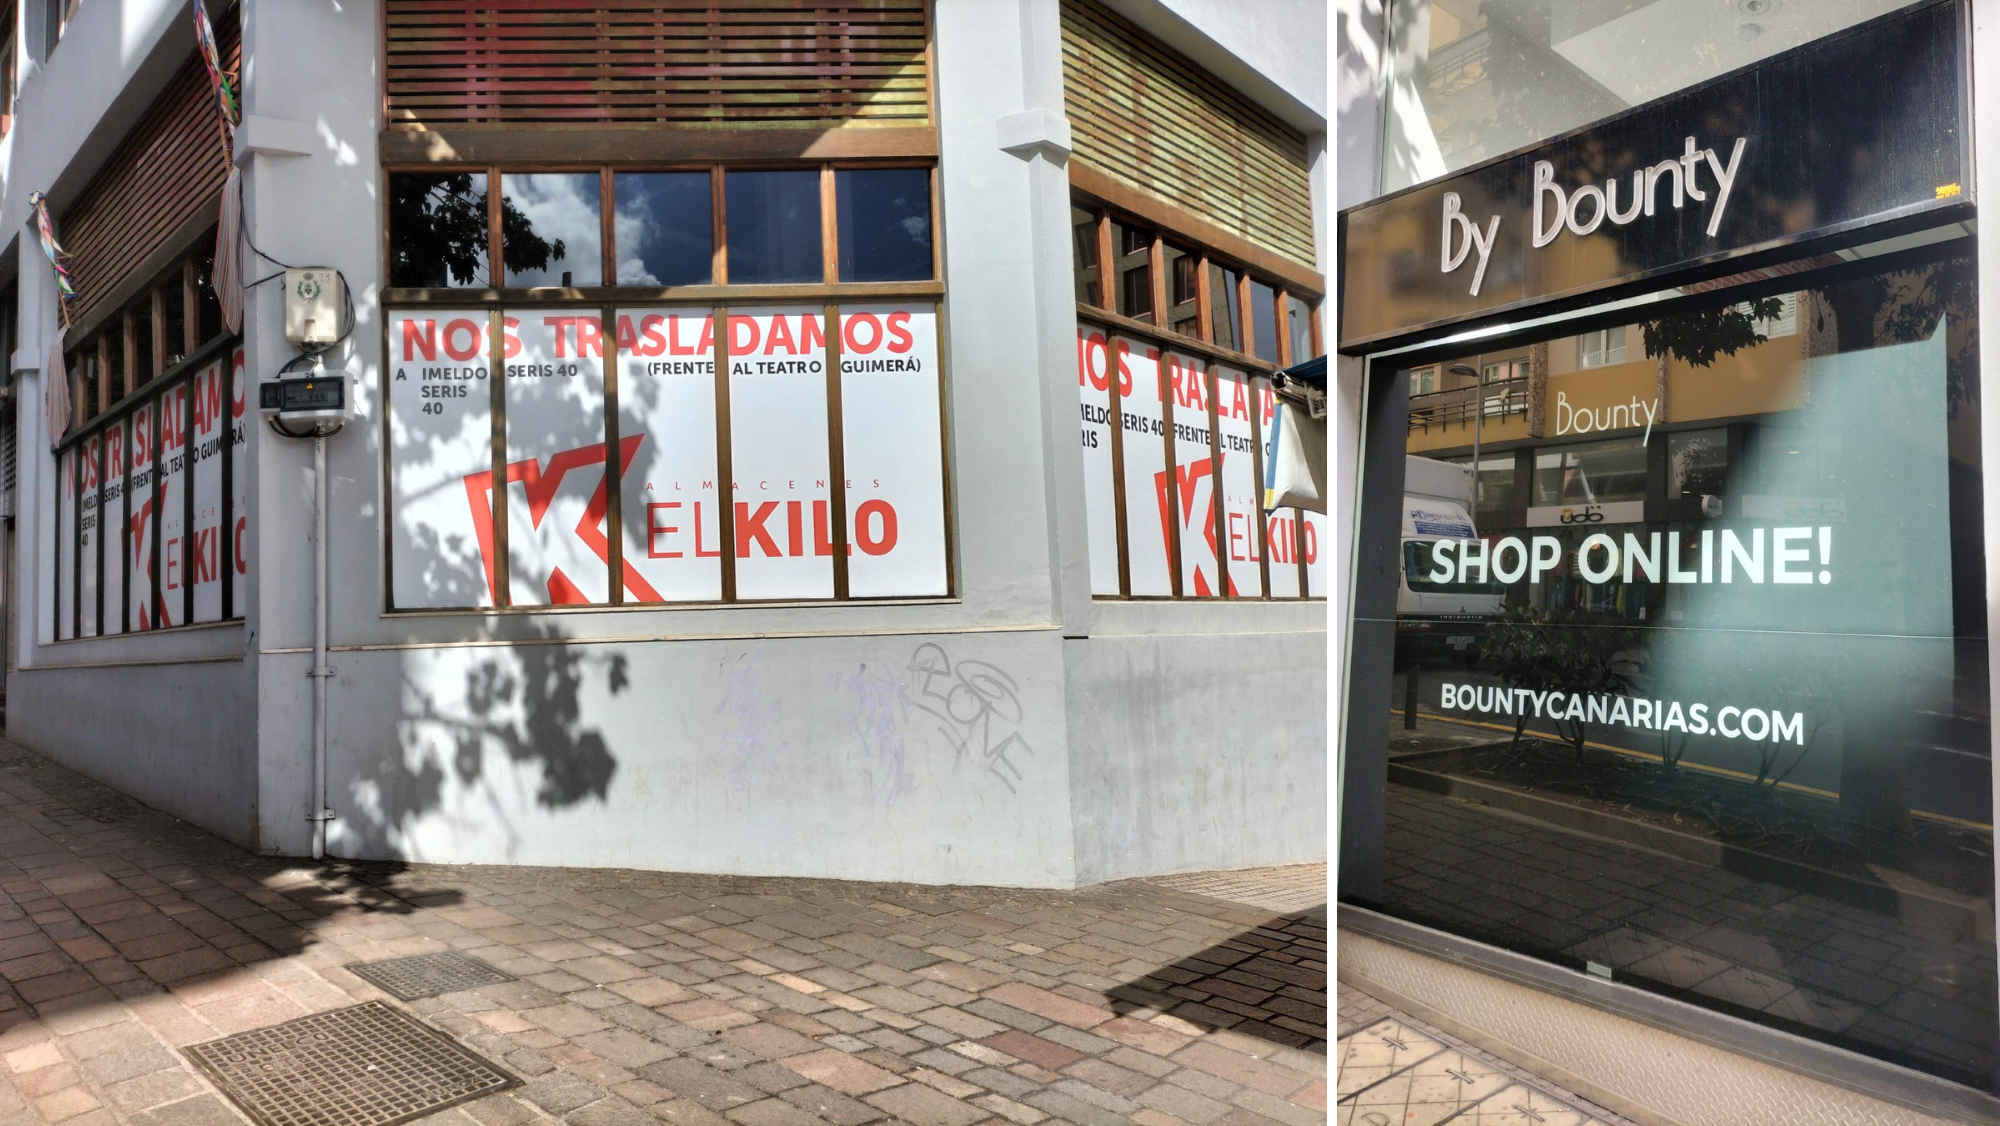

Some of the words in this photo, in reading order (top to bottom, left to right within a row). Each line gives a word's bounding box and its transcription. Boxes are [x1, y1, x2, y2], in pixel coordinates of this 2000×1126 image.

[1441, 192, 1502, 297] By
[1531, 136, 1747, 249] Bounty
[544, 311, 914, 359] TRASLADAMOS
[395, 368, 408, 381] A
[421, 366, 488, 382] IMELDO
[507, 364, 554, 378] SERIS
[556, 363, 579, 378] 40
[647, 361, 715, 376] (FRENTE
[732, 362, 753, 375] AL
[756, 360, 823, 375] TEATRO
[841, 356, 922, 373] GUIMERÁ)
[420, 384, 468, 399] SERIS
[421, 401, 444, 416] 40
[1556, 391, 1659, 447] Bounty
[646, 478, 881, 492] ALMACENES
[1429, 535, 1563, 586] SHOP
[1577, 526, 1833, 586] ONLINE!
[1440, 682, 1805, 746] BOUNTYCANARIAS.COM
